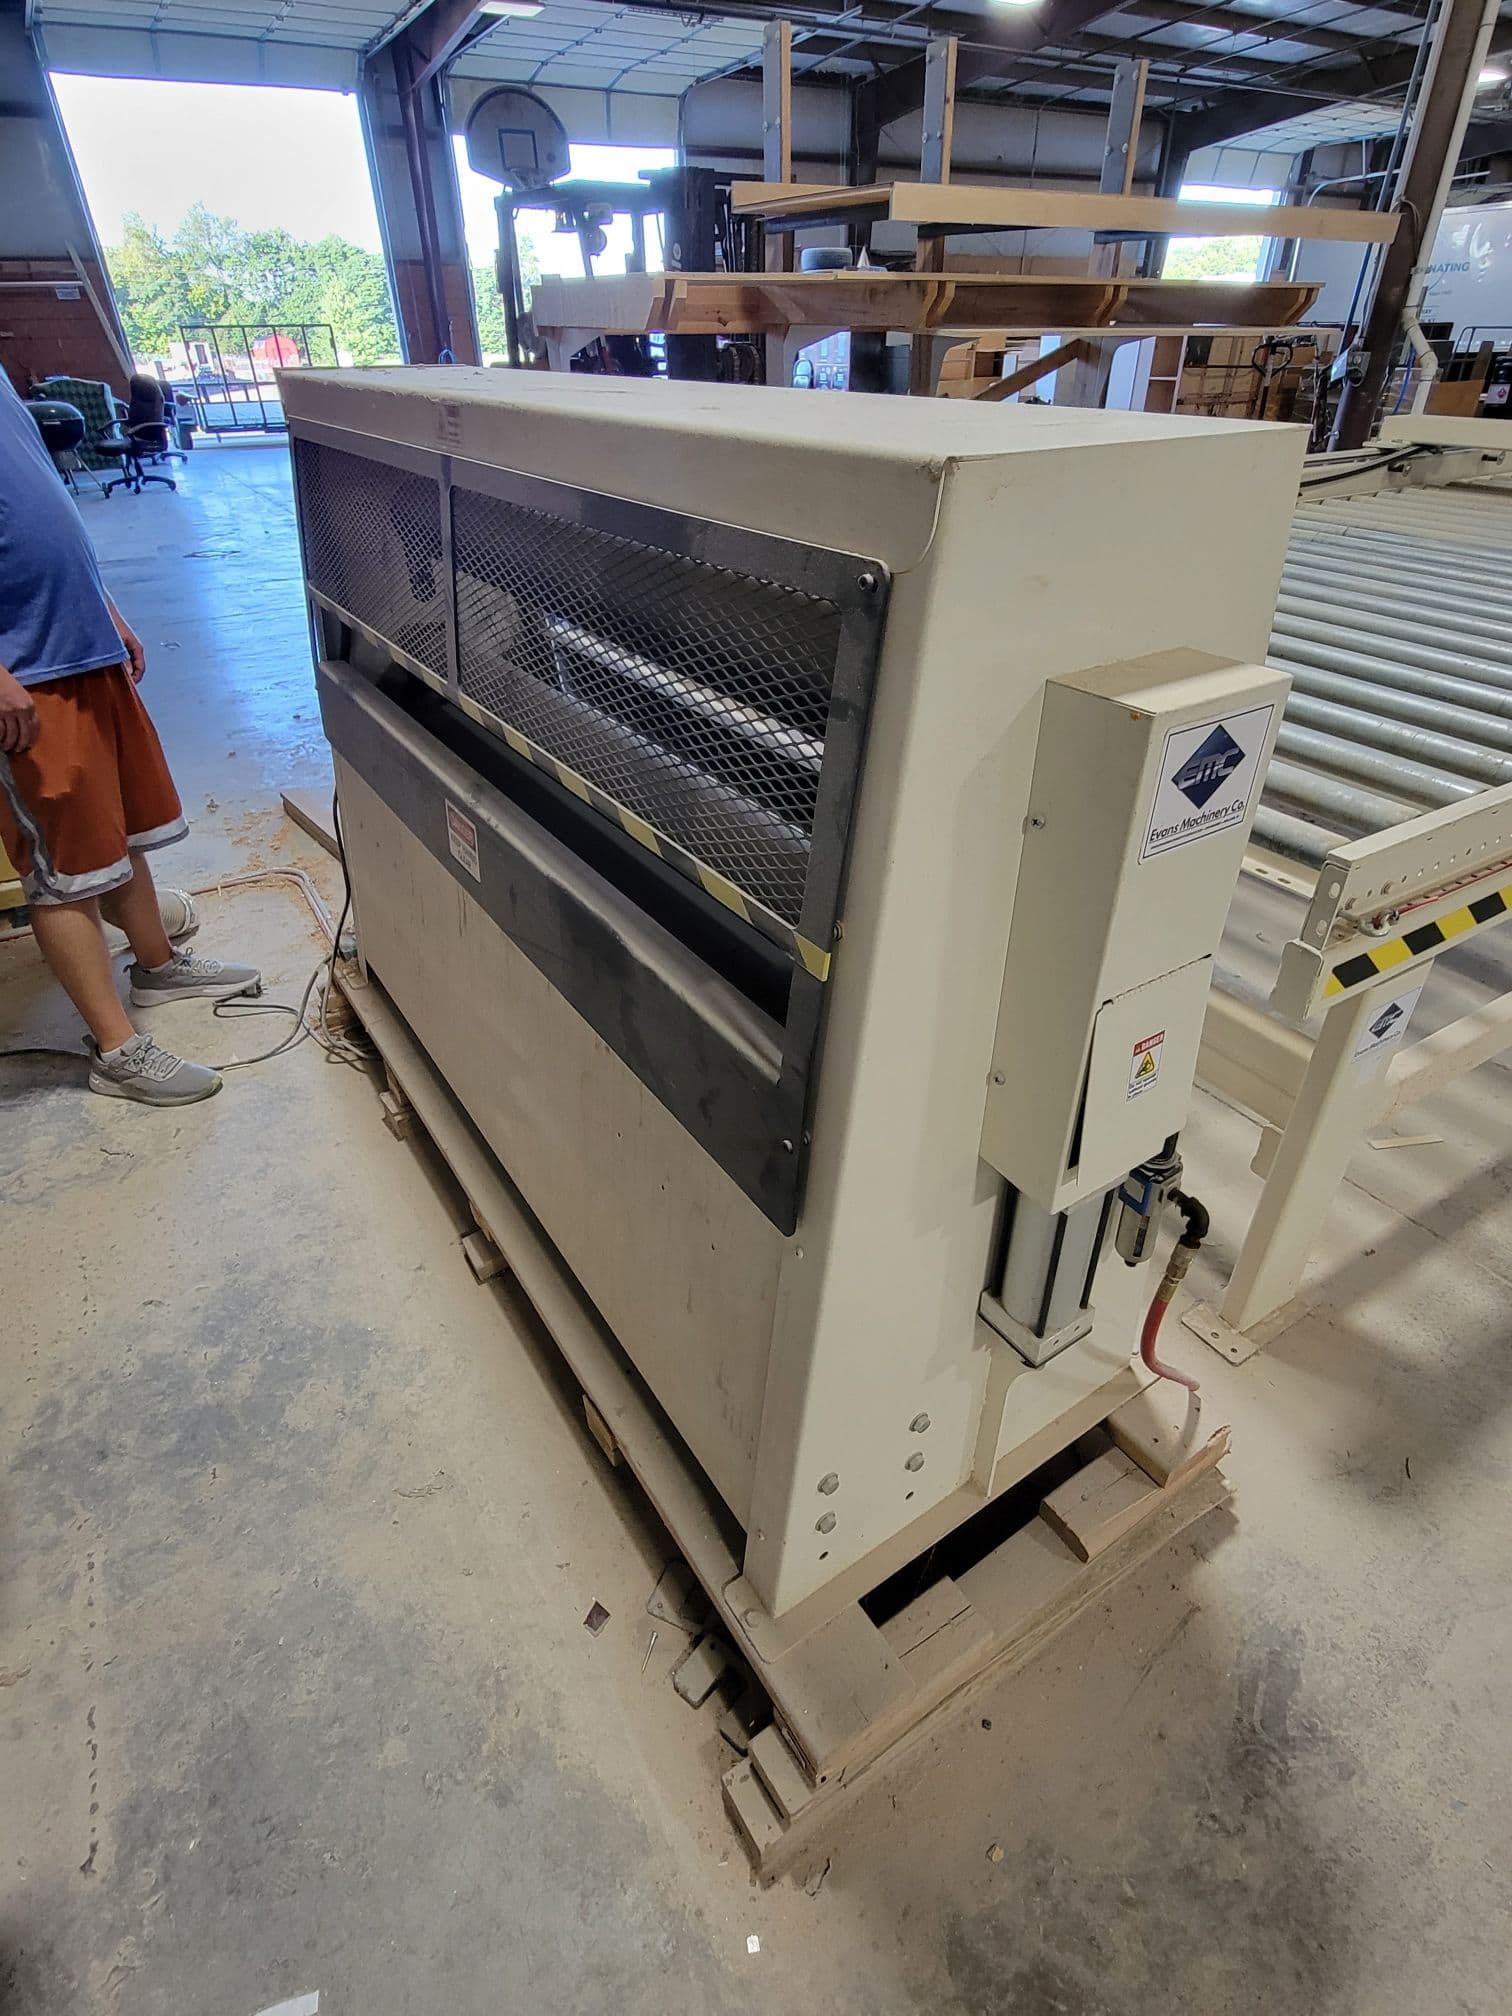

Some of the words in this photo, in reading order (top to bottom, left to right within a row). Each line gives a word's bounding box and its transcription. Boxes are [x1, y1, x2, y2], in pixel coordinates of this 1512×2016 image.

[1429, 262, 1470, 272] NATING
[1150, 824, 1179, 841] Evans
[1180, 805, 1231, 829] Machinery
[1231, 799, 1245, 811] Co.
